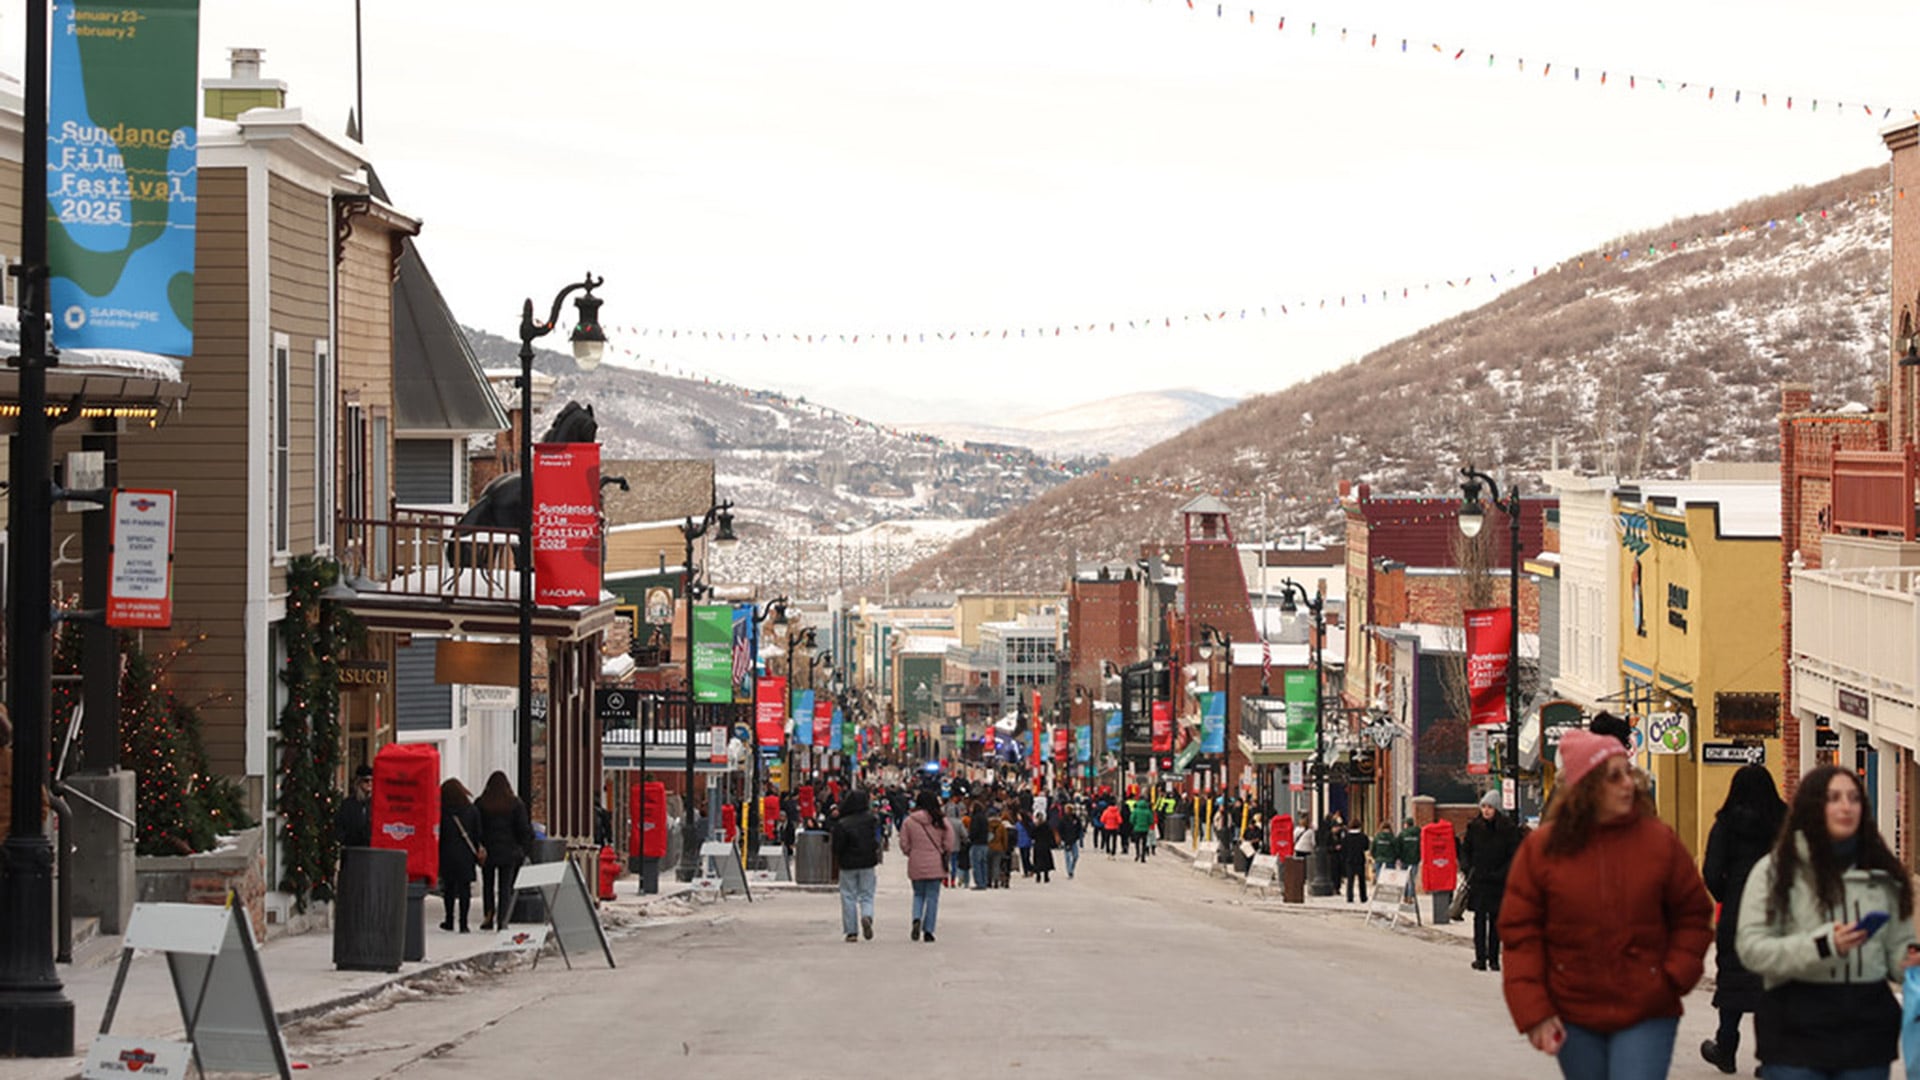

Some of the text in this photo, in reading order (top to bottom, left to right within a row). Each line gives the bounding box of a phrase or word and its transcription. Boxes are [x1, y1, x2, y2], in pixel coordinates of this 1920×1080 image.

[66, 9, 120, 24] January
[66, 24, 136, 40] February 2
[62, 121, 187, 145] Sundance
[62, 147, 125, 169] Film
[61, 173, 182, 197] Festival
[61, 199, 122, 221] 2025
[539, 503, 595, 514] Sundance
[539, 515, 567, 525] Film
[539, 527, 594, 538] Festival
[549, 588, 587, 597] ACURA
[1707, 748, 1746, 759] ONE WAY
[100, 1062, 168, 1076] SPECIAL EVENTS
